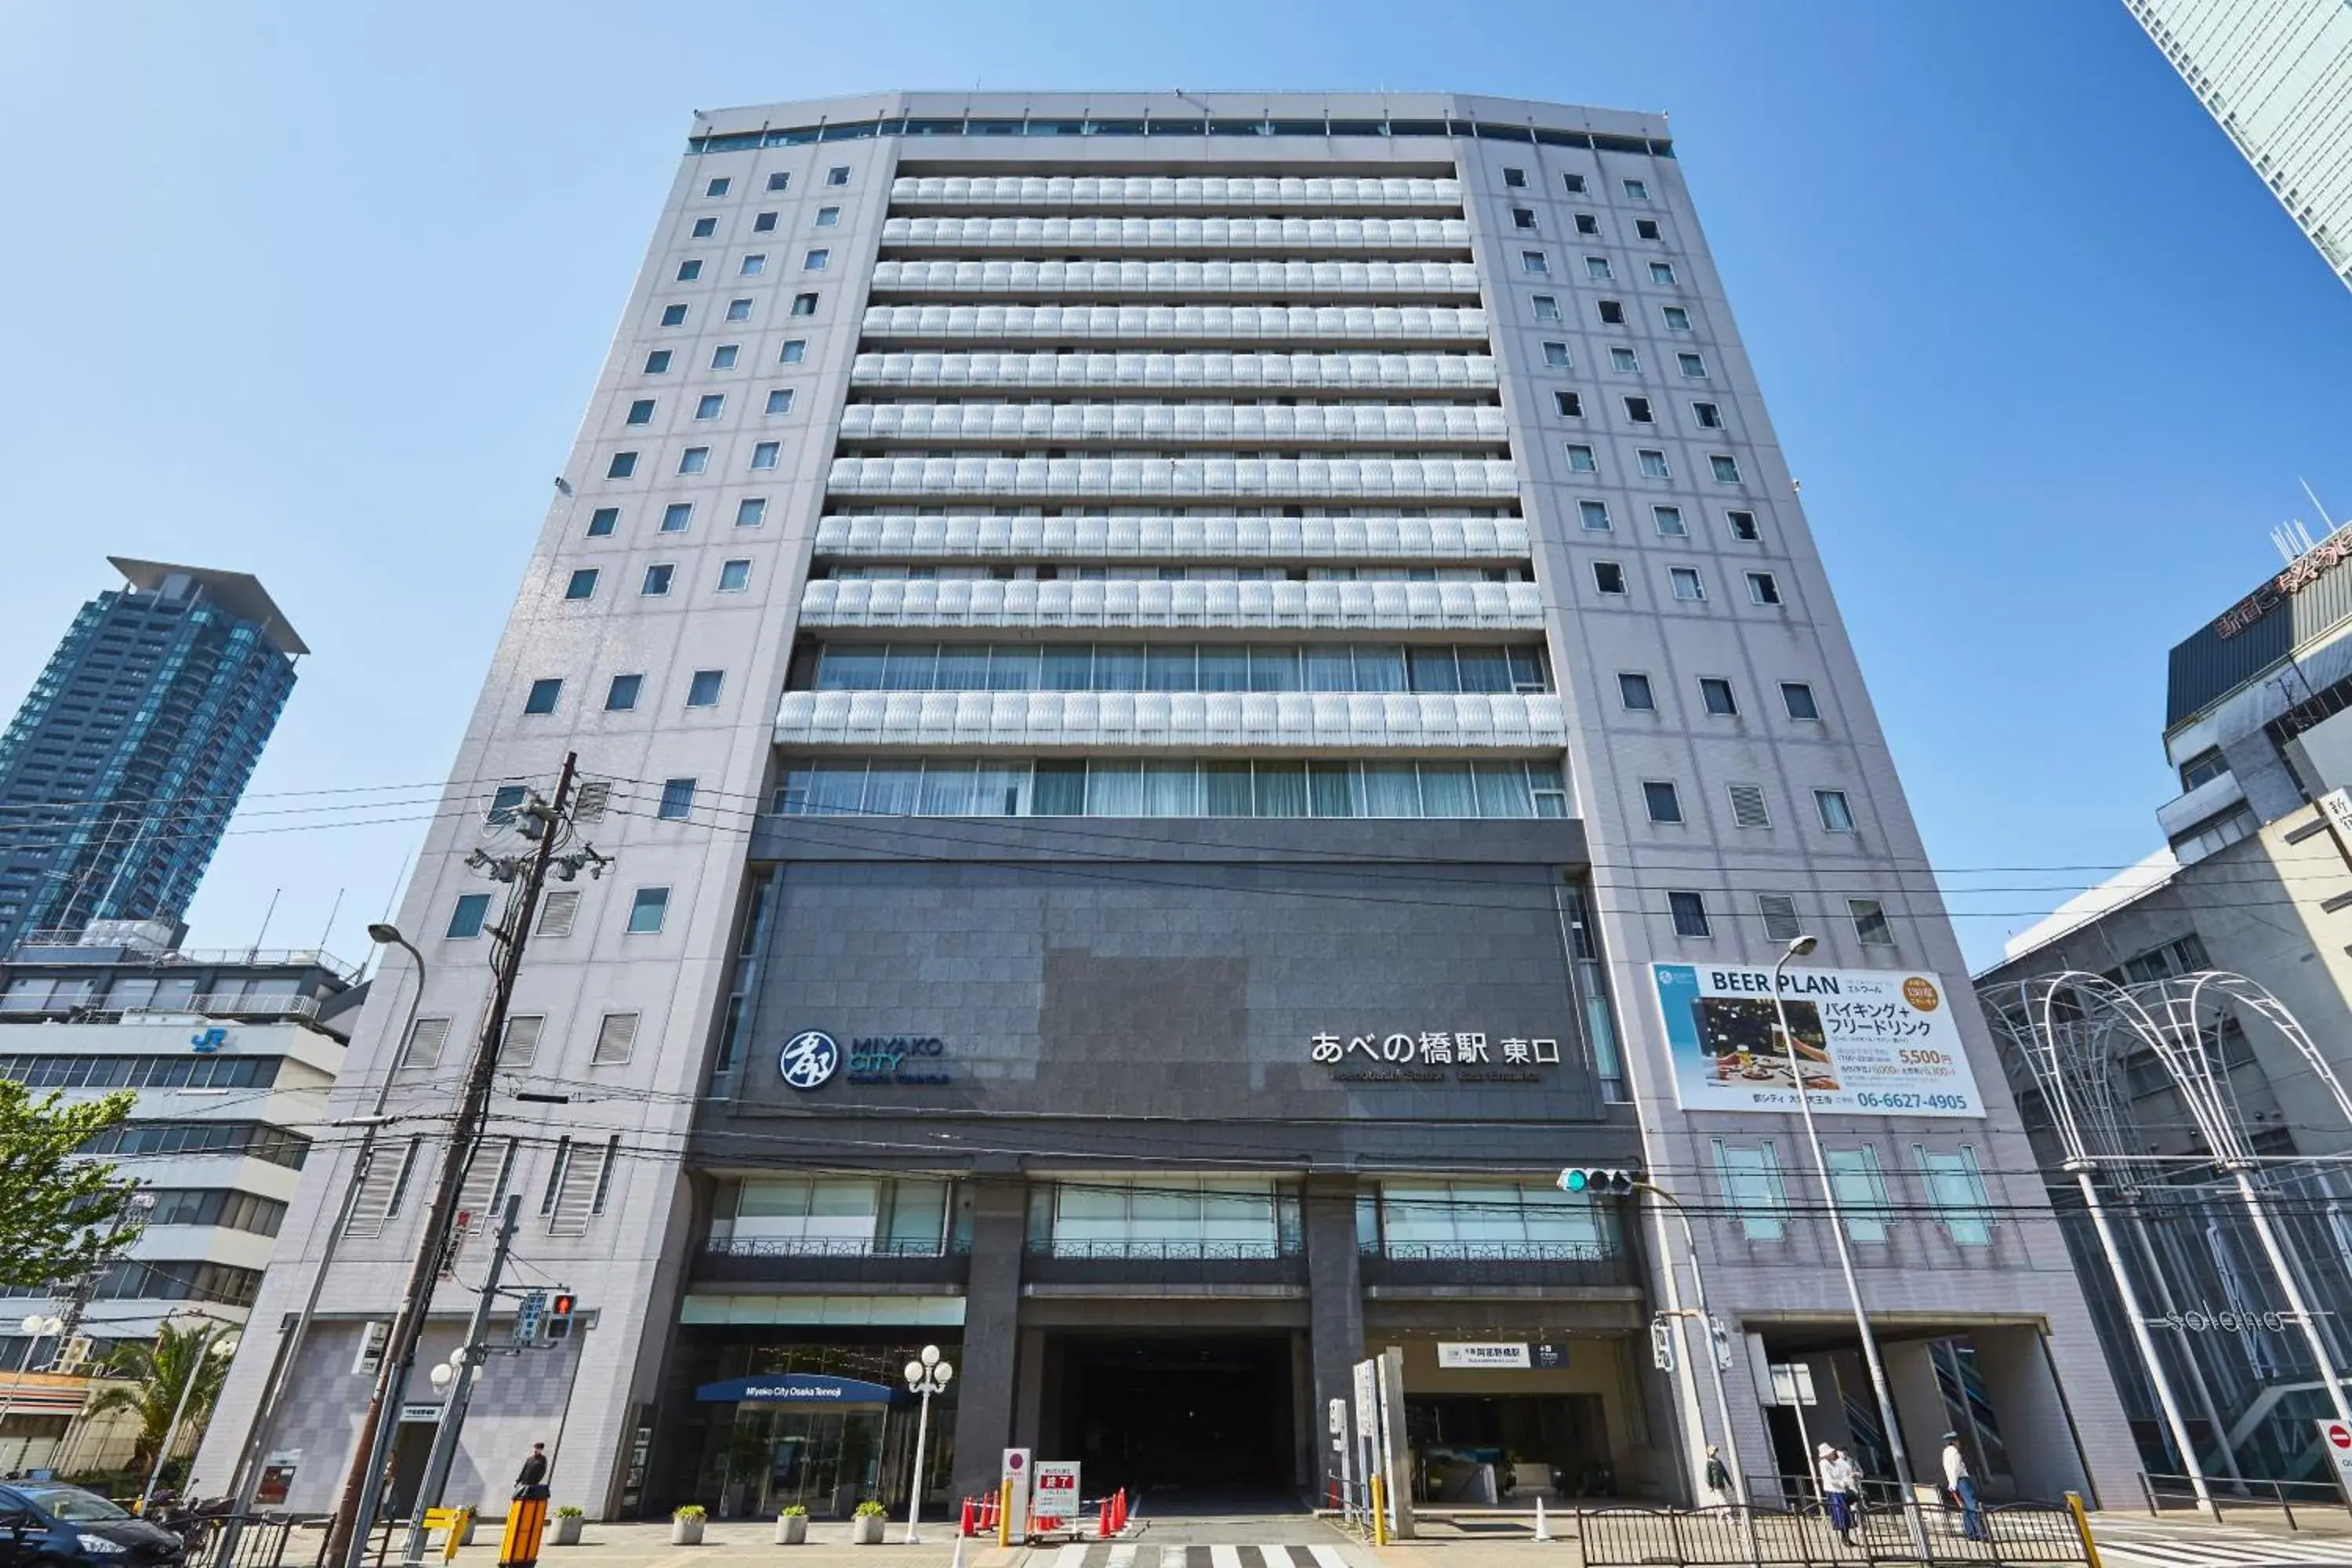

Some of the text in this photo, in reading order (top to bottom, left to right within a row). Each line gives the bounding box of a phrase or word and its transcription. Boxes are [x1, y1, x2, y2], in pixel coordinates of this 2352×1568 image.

[1712, 971, 1770, 993] BEER
[1777, 975, 1840, 995] PLAN
[1828, 1018, 1931, 1036] フリードリンク
[191, 1028, 227, 1046] JR
[851, 1038, 943, 1056] MIYAKO
[1312, 1031, 1559, 1064] あべの橋駅 東口
[849, 1053, 903, 1071] CITY
[1857, 1092, 1967, 1110] 06-6627-4905
[2166, 1299, 2285, 1331] solaha
[746, 1387, 841, 1398] Miyako City Osaka Tennoji
